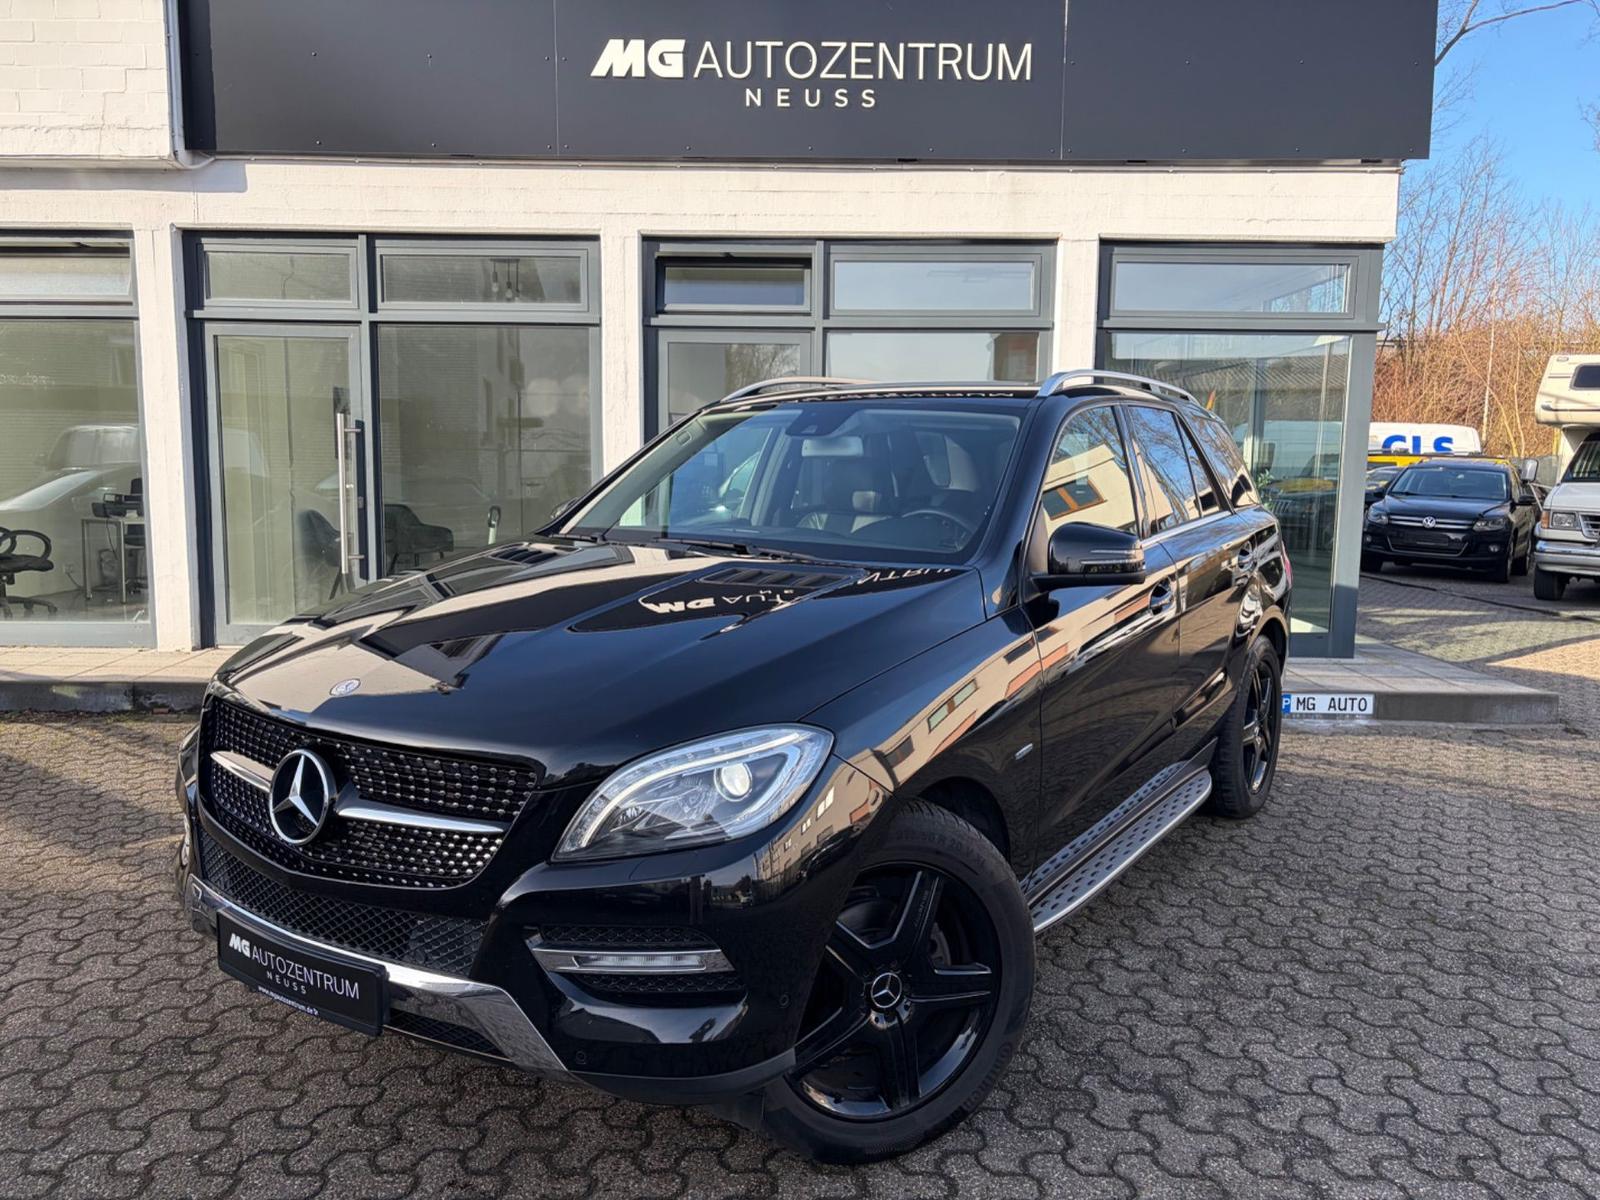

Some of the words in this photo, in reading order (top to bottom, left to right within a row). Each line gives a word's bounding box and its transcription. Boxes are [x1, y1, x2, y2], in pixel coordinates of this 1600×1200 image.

[590, 38, 686, 78] MG
[693, 41, 1033, 81] AUTOZENTRUM
[745, 87, 876, 108] NEUSS
[1296, 696, 1316, 711] MG
[1328, 697, 1368, 712] AUTO
[229, 932, 251, 958] MG
[252, 945, 360, 1000] AUTOZENTRUM
[267, 971, 307, 995] NEUSS
